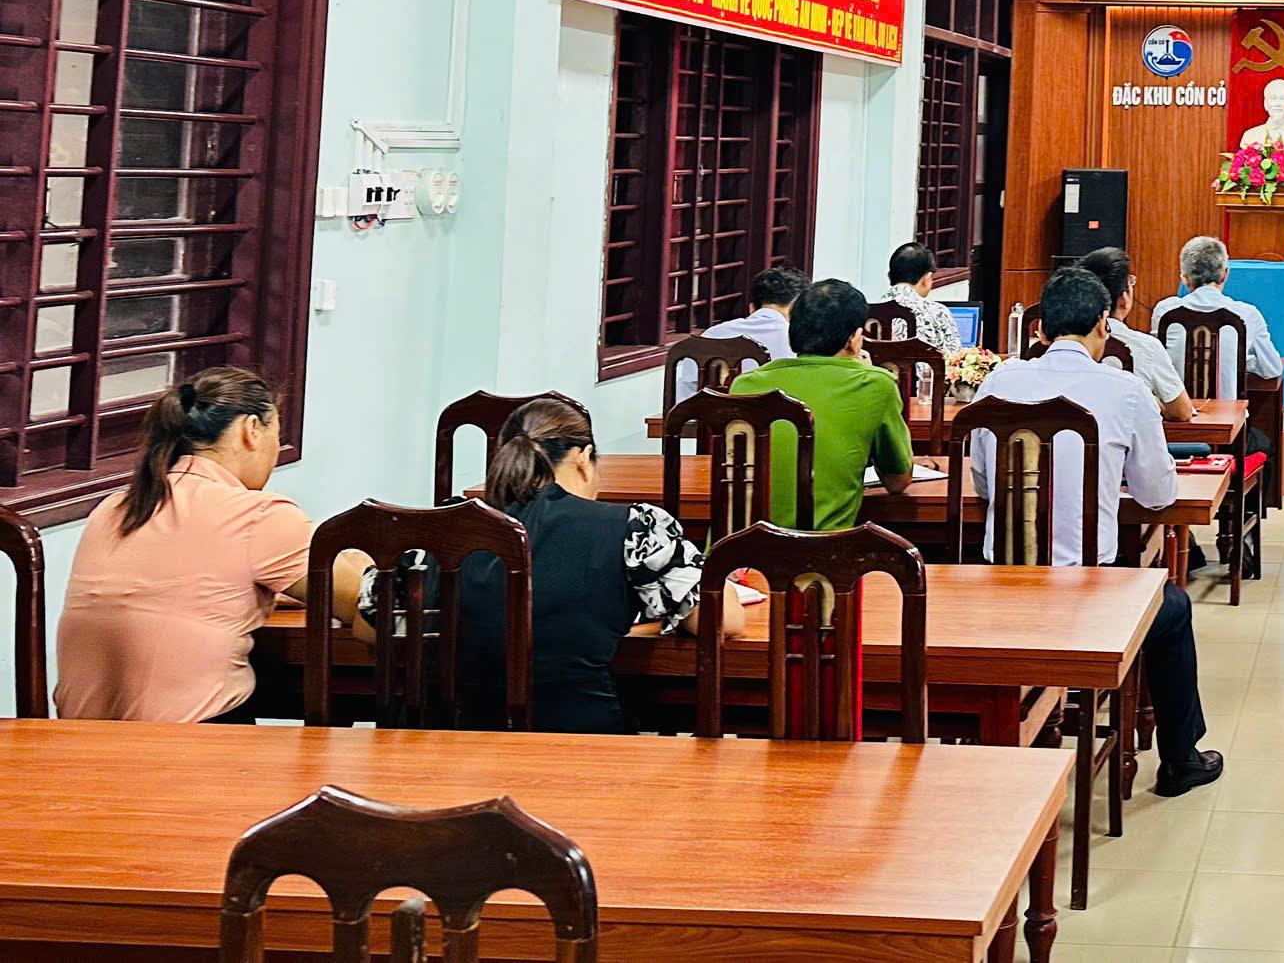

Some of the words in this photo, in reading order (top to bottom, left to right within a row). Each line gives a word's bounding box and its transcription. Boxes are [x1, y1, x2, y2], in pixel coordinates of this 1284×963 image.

[1112, 82, 1142, 109] ĐẶC
[1143, 86, 1173, 106] KHU
[1175, 80, 1205, 106] CỒN
[1207, 80, 1227, 106] CỎ
